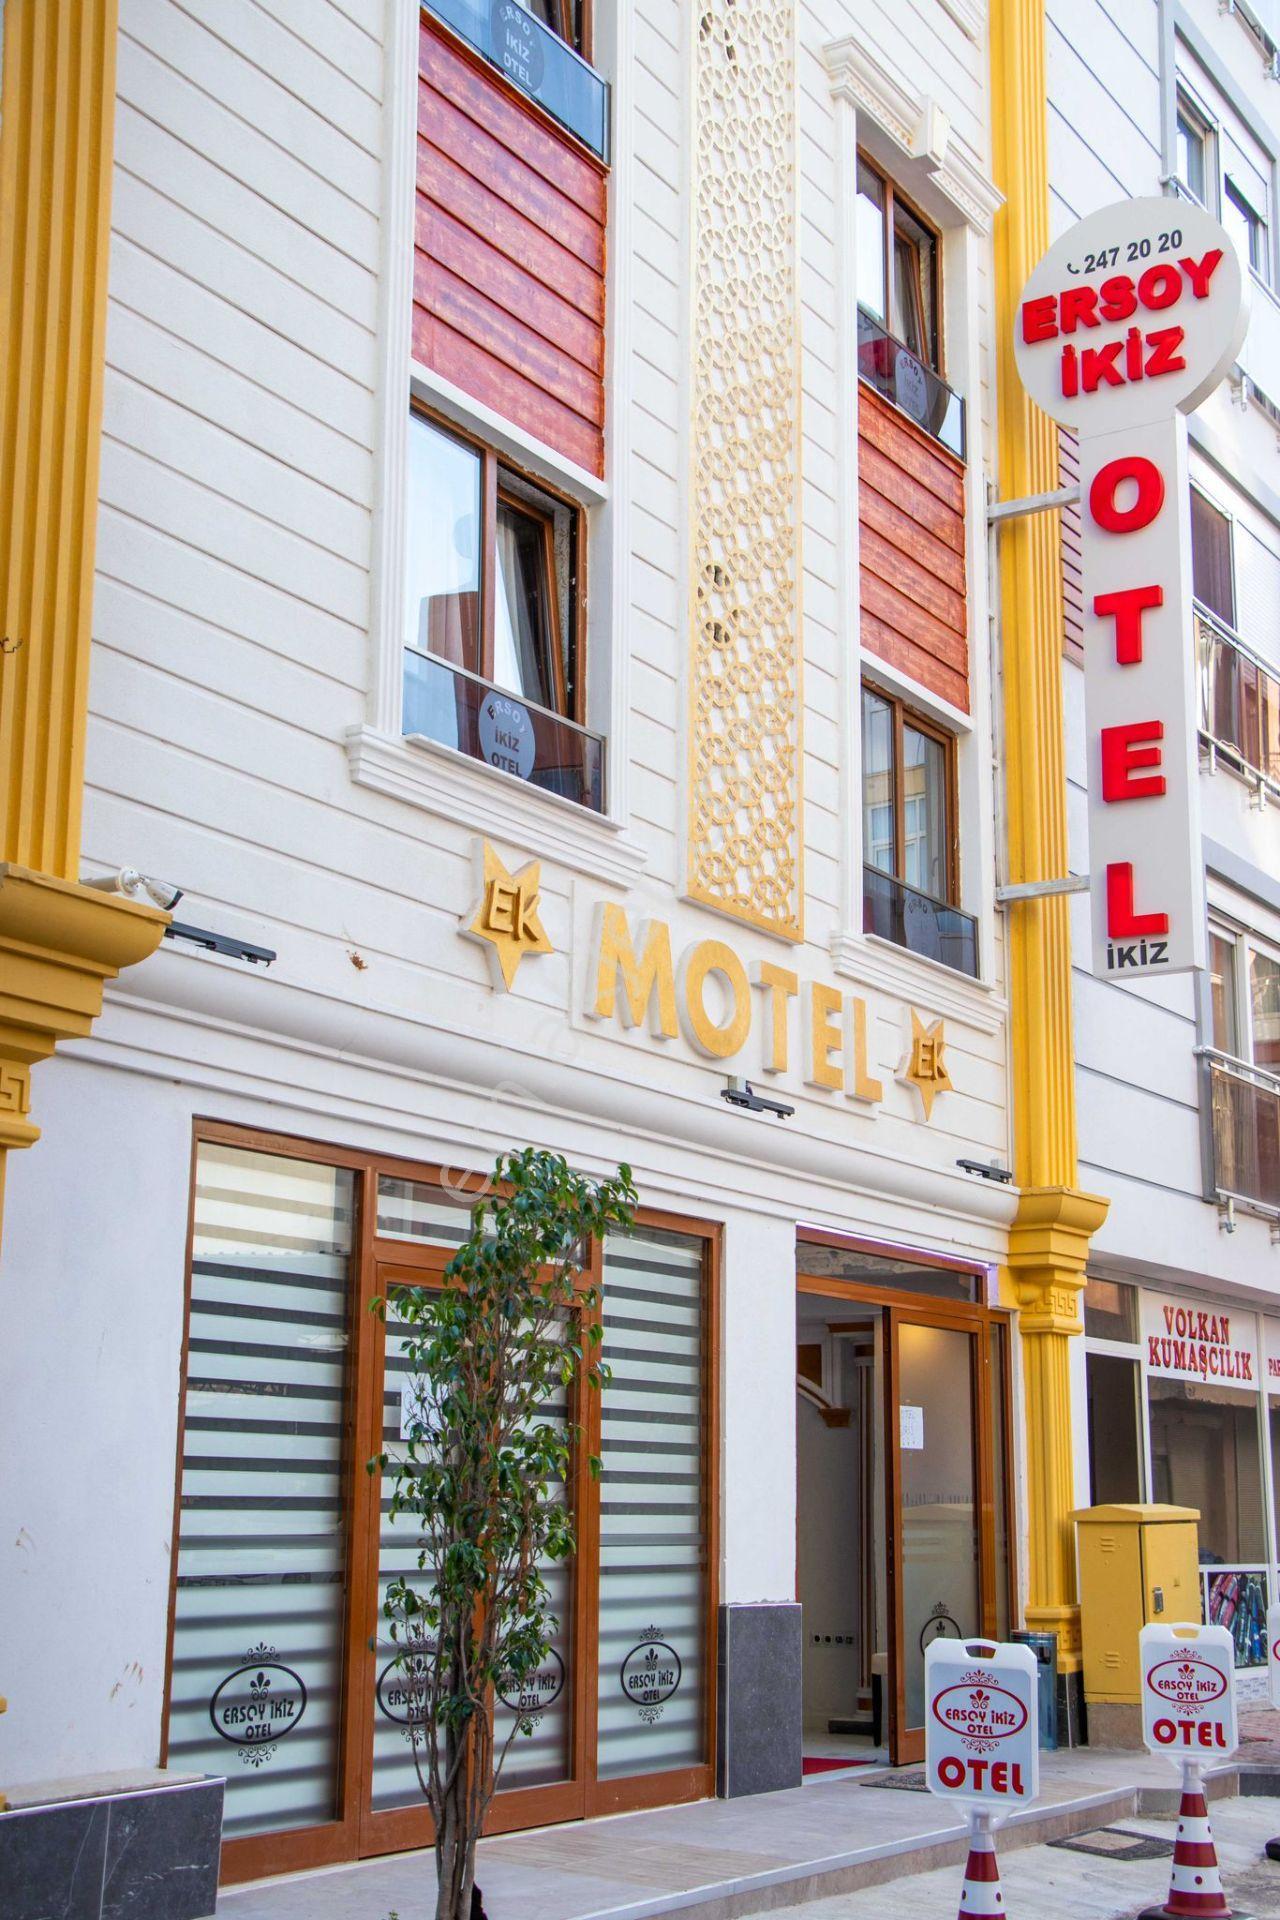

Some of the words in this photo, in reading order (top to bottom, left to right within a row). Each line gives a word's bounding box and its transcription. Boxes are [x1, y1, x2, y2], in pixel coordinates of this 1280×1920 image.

[1084, 246, 1120, 274] 247
[1127, 238, 1151, 262] 20
[1158, 229, 1182, 253] 20
[1022, 248, 1224, 345] ERSOY
[1061, 325, 1186, 398] İKİZ
[1089, 456, 1169, 939] OTEL
[495, 726, 520, 753] İKİZ
[491, 752, 523, 778] OTEL
[486, 879, 541, 942] EK
[1107, 939, 1169, 970] İKİZ
[584, 901, 883, 1103] MOTEL
[914, 1037, 948, 1081] EK
[1163, 1305, 1230, 1345] VOLKAN
[1148, 1336, 1253, 1381] KUMAŞCILIK
[538, 1673, 556, 1690] İKİZ
[629, 1673, 656, 1689] ERSOY
[658, 1669, 674, 1686] İKİZ
[1158, 1680, 1192, 1691] ERSOY
[1196, 1680, 1217, 1692] İKİZ
[520, 1694, 539, 1707] OTEL
[643, 1689, 660, 1701] OTEL
[1177, 1692, 1199, 1700] OTEL
[223, 1703, 266, 1725] ERSOY
[270, 1698, 294, 1719] İKİZ
[946, 1708, 986, 1722] ERSOY
[991, 1710, 1016, 1726] İKİZ
[246, 1723, 272, 1739] OTEL
[967, 1724, 993, 1735] OTEL
[1153, 1718, 1226, 1748] OTEL
[938, 1756, 1024, 1795] OTEL
